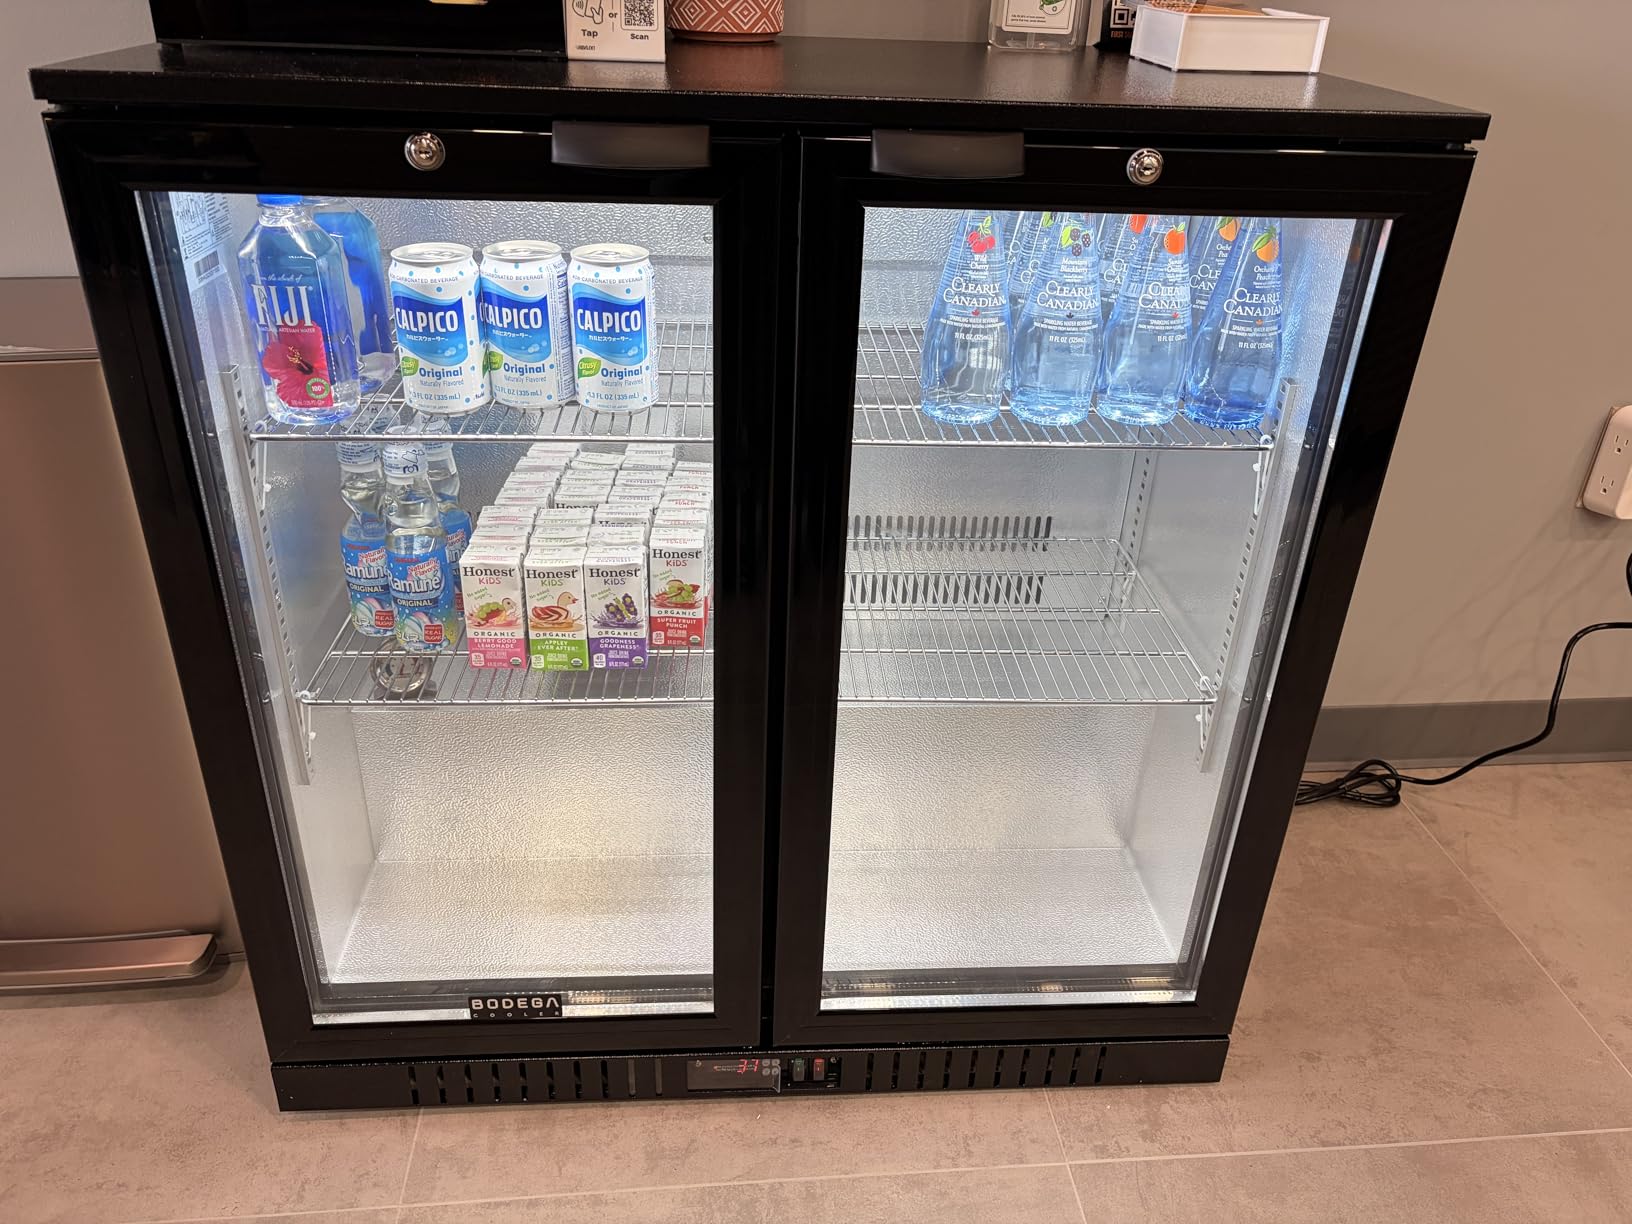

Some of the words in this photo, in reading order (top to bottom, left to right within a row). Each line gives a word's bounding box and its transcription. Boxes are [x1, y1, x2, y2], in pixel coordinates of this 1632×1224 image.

[581, 29, 598, 38] Tap
[944, 288, 1006, 308] CANADIAN
[251, 284, 313, 326] FIJI
[395, 308, 458, 333] CALPICO
[484, 303, 542, 329] CALPICO
[577, 309, 641, 333] CALPICO
[419, 367, 462, 380] Original
[503, 363, 545, 376] Original
[601, 366, 642, 380] Original
[652, 549, 702, 559] Honest
[463, 567, 515, 577] Honest
[526, 569, 578, 579] Honest
[589, 568, 640, 578] Honest
[350, 584, 384, 592] ORIGINAL
[397, 598, 432, 606] ORIGINAL
[472, 997, 559, 1010] BODEGA
